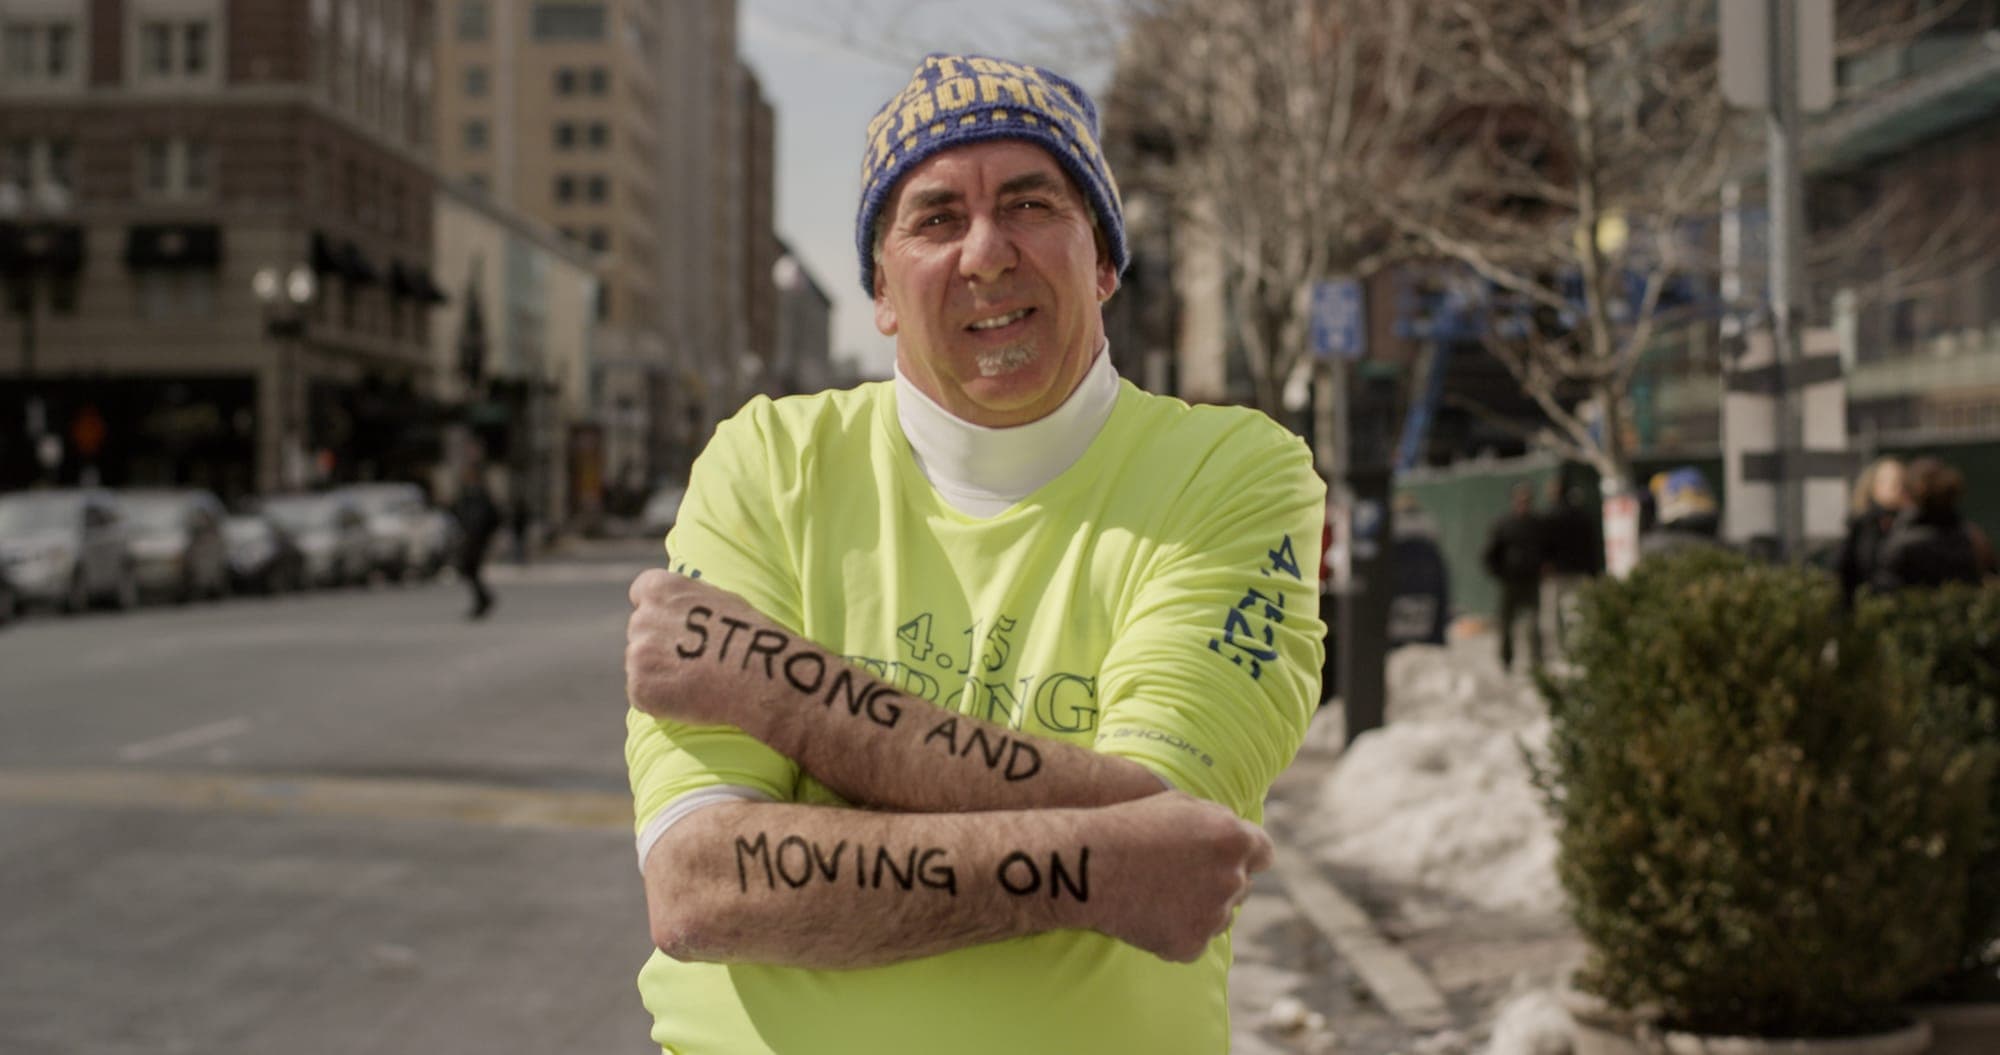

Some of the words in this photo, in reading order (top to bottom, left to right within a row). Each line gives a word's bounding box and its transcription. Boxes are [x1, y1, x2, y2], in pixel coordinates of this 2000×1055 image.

[897, 612, 1017, 676] 4.15
[676, 606, 902, 729] STRONG
[924, 717, 1042, 782] AND
[734, 832, 957, 897] MOVING
[997, 847, 1090, 903] ON
